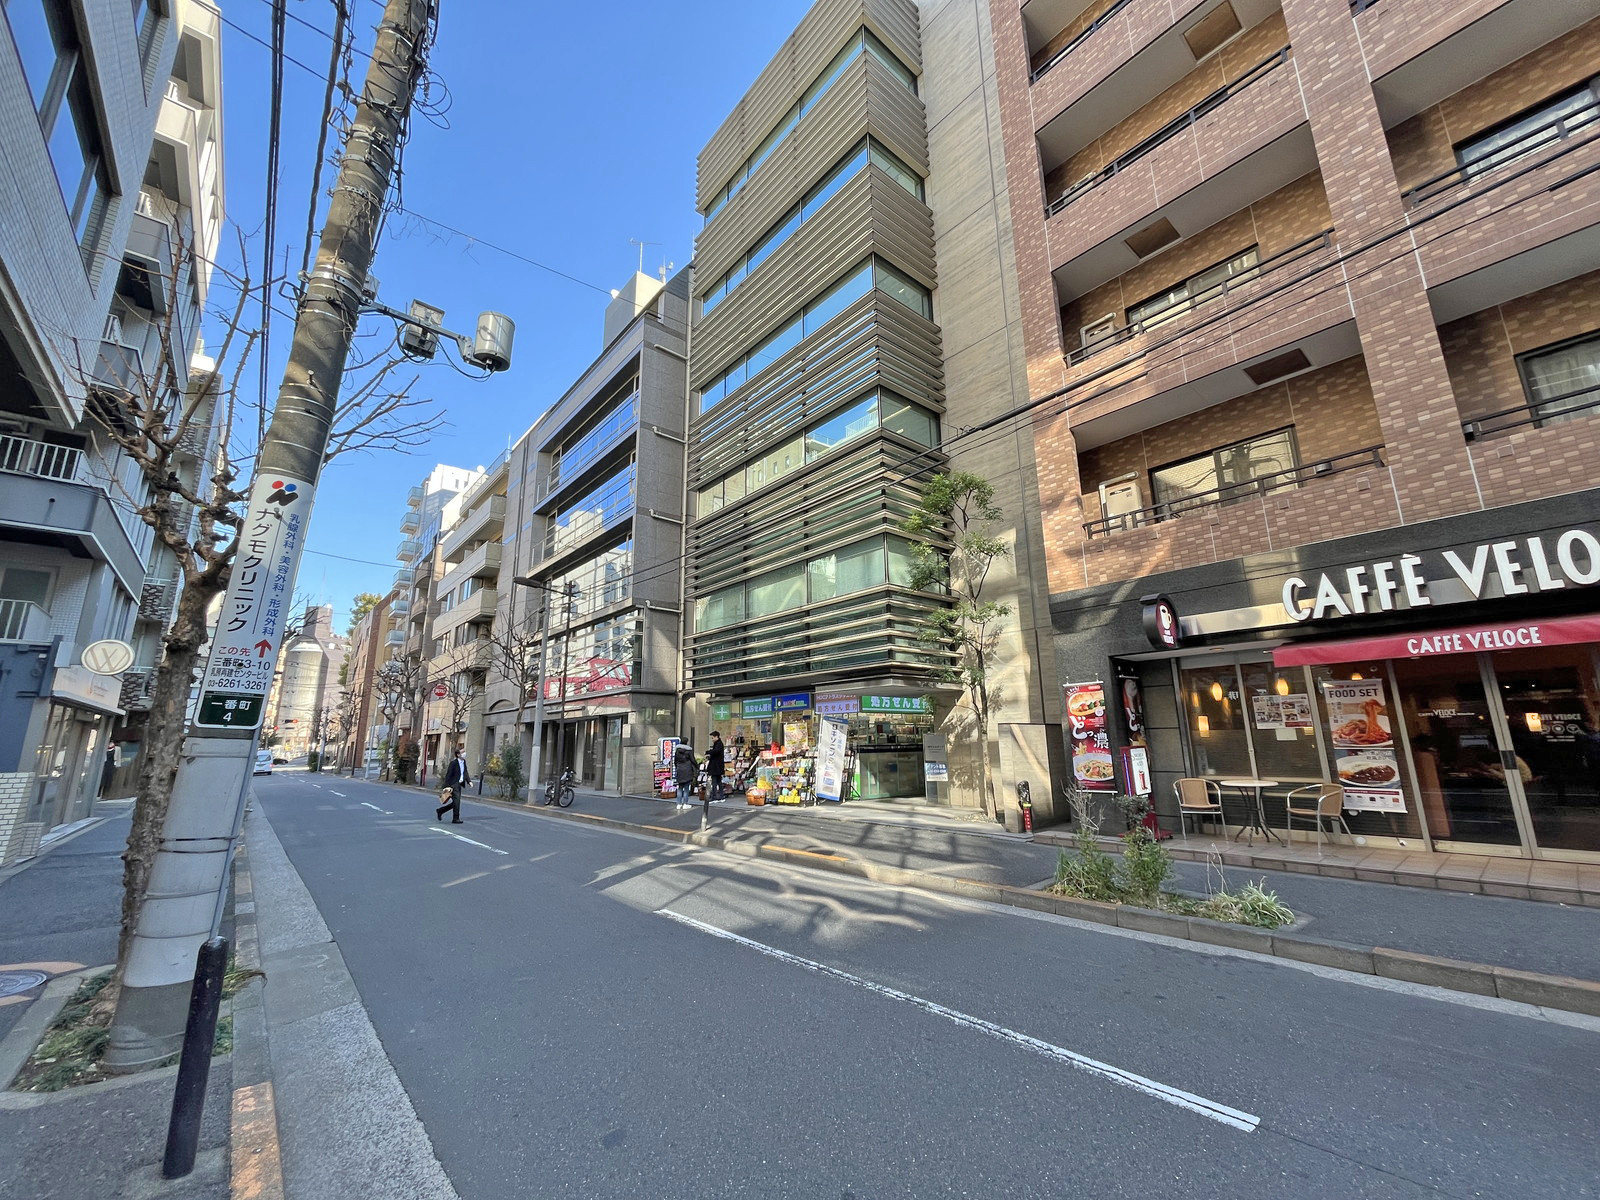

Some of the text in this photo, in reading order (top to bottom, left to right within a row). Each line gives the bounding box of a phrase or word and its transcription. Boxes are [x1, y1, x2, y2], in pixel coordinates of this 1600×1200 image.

[228, 509, 275, 632] ナグモクリニック
[1282, 529, 1600, 622] CAFFÈ VELO
[1407, 626, 1542, 655] CAFFÈ VELOCE
[218, 646, 251, 658] この先
[207, 678, 268, 691] 03-6261-3261
[1328, 688, 1380, 699] FOOD SET
[210, 698, 252, 711] 一番町
[223, 711, 233, 722] 4
